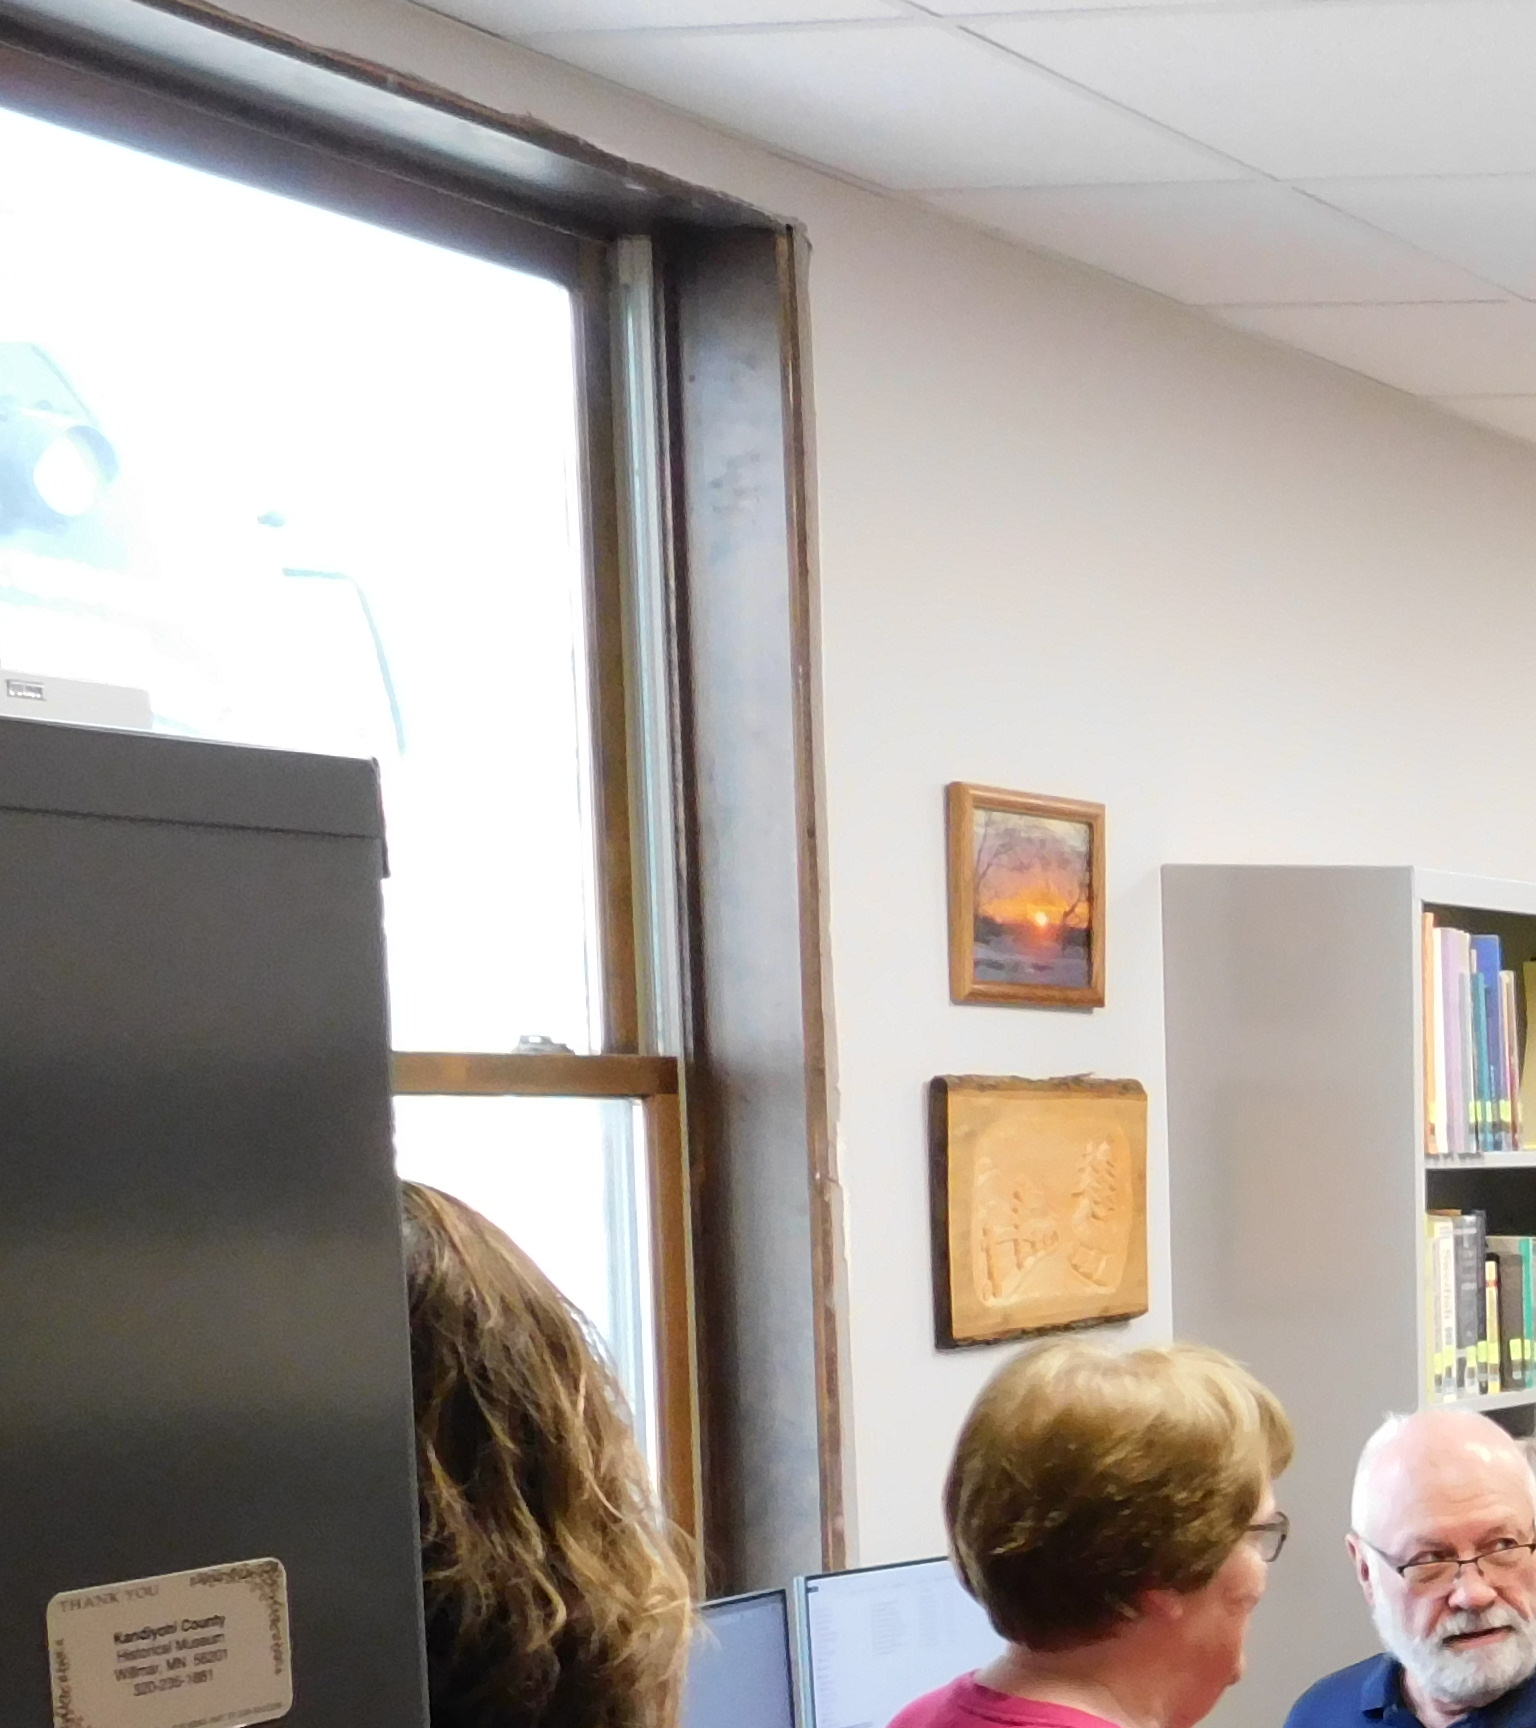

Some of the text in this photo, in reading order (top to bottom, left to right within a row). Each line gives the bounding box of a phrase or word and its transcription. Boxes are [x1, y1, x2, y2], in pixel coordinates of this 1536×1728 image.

[60, 1584, 159, 1613] THANK YOU
[180, 1614, 226, 1632] County
[175, 1633, 225, 1651] Museum
[165, 1656, 187, 1671] MN
